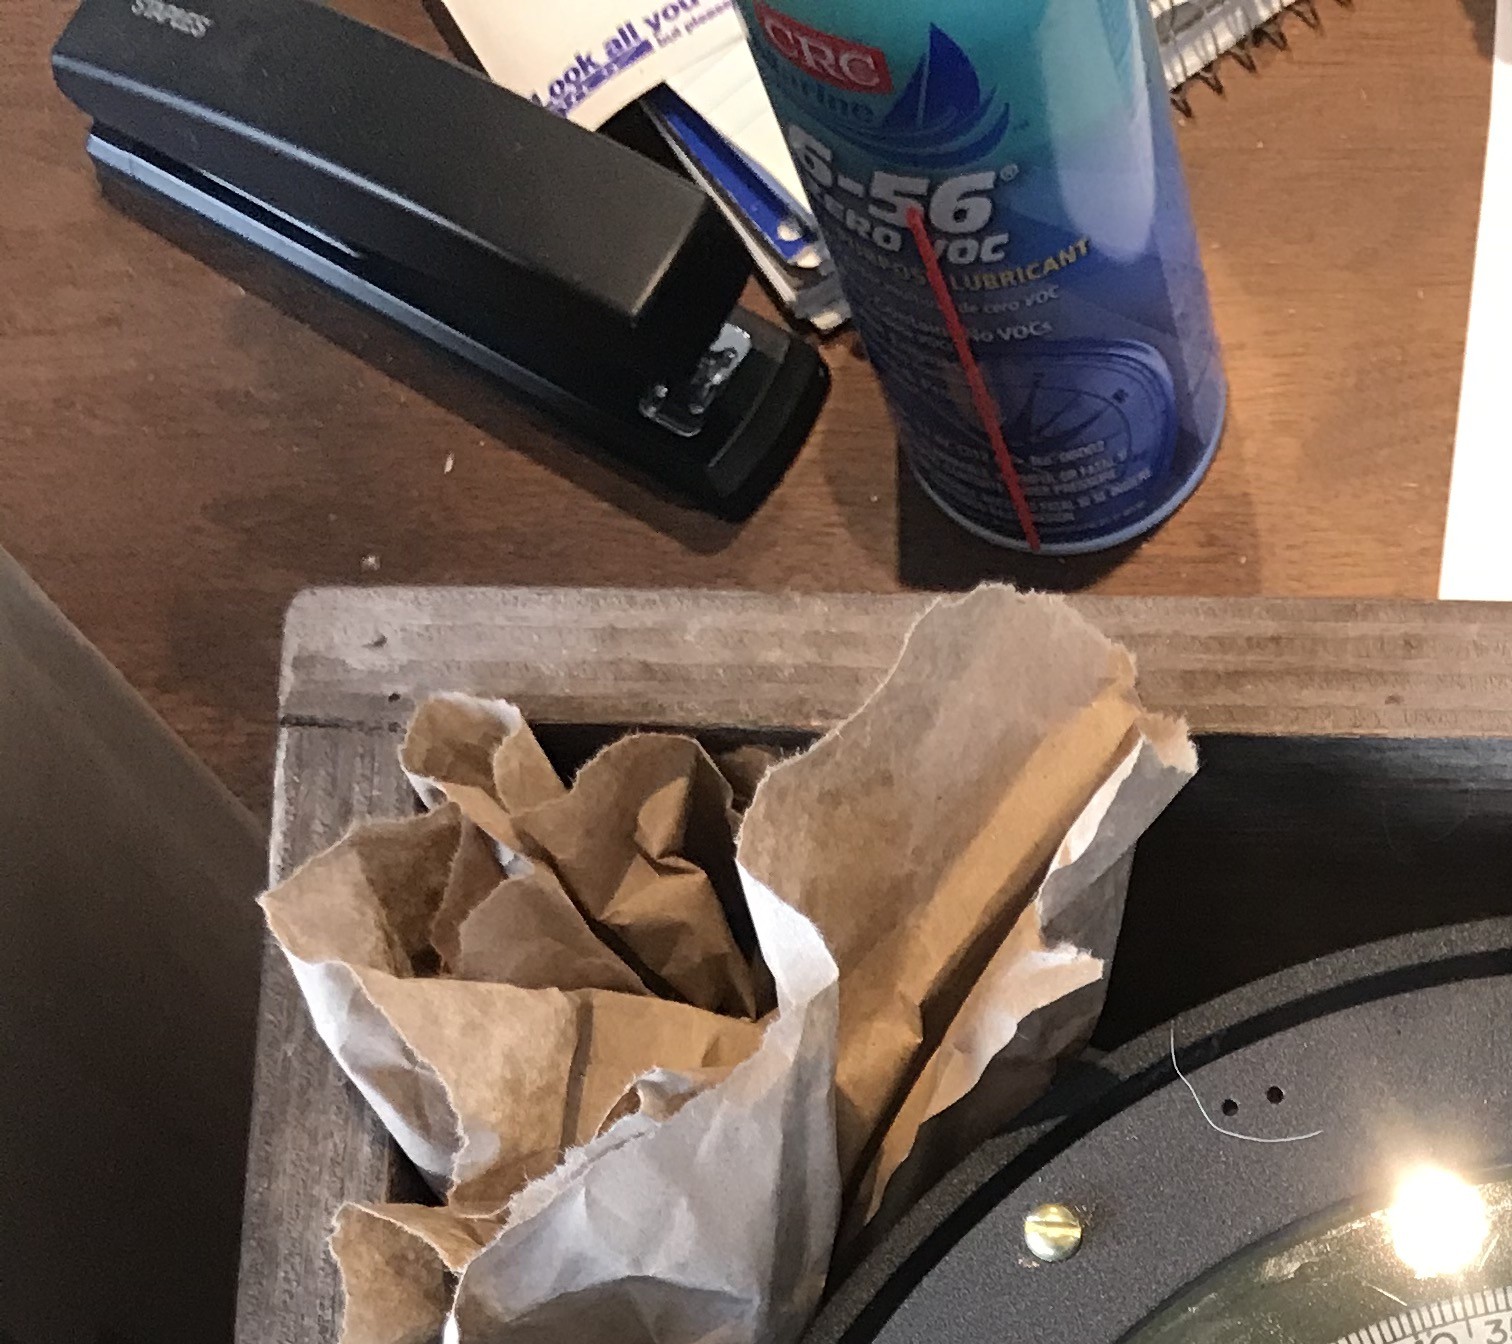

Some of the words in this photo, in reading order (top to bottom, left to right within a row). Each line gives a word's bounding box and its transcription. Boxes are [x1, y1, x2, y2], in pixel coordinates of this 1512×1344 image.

[603, 20, 642, 60] all
[764, 17, 880, 87] CRC
[951, 237, 1089, 291] LUBRICANT
